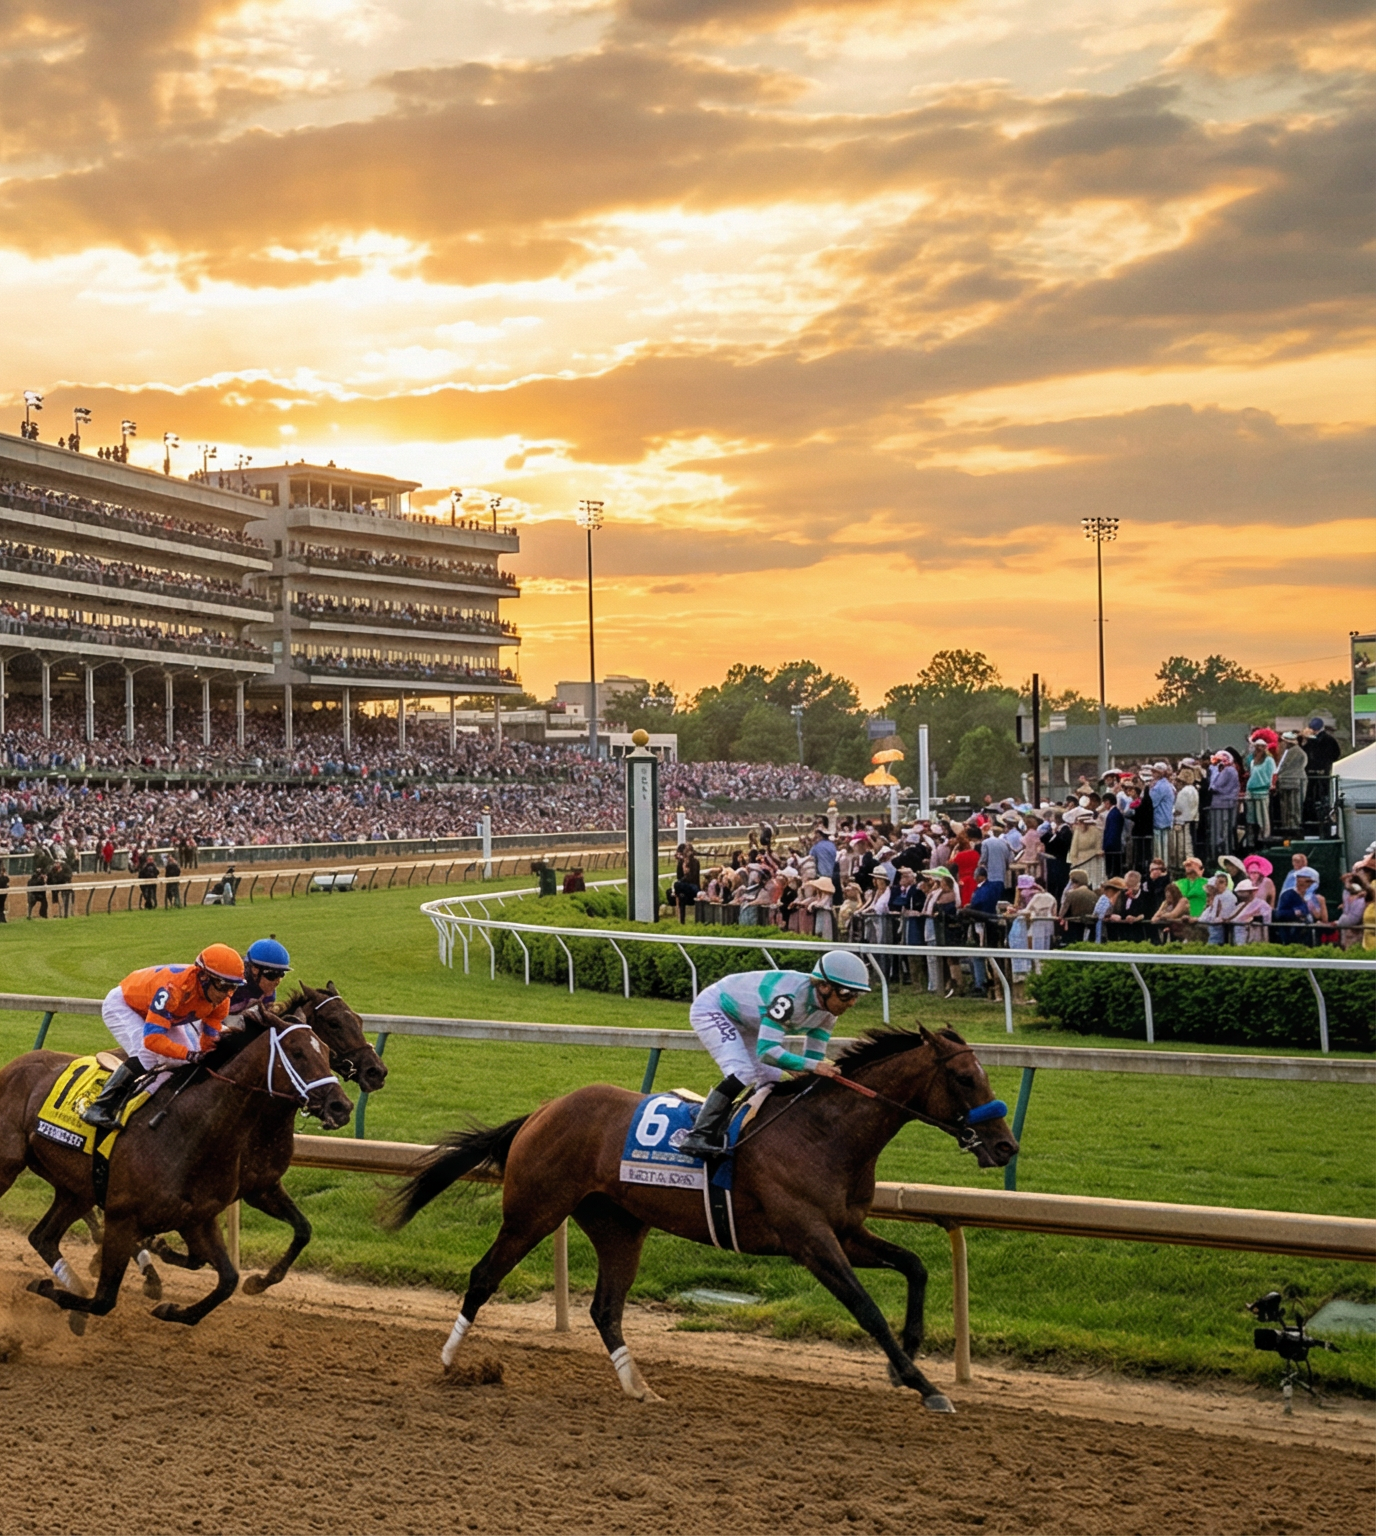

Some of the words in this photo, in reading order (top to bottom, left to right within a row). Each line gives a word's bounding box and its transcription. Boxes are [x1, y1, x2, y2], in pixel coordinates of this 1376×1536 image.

[154, 991, 169, 1010] 3
[54, 1065, 90, 1109] 1
[635, 1096, 682, 1147] 6
